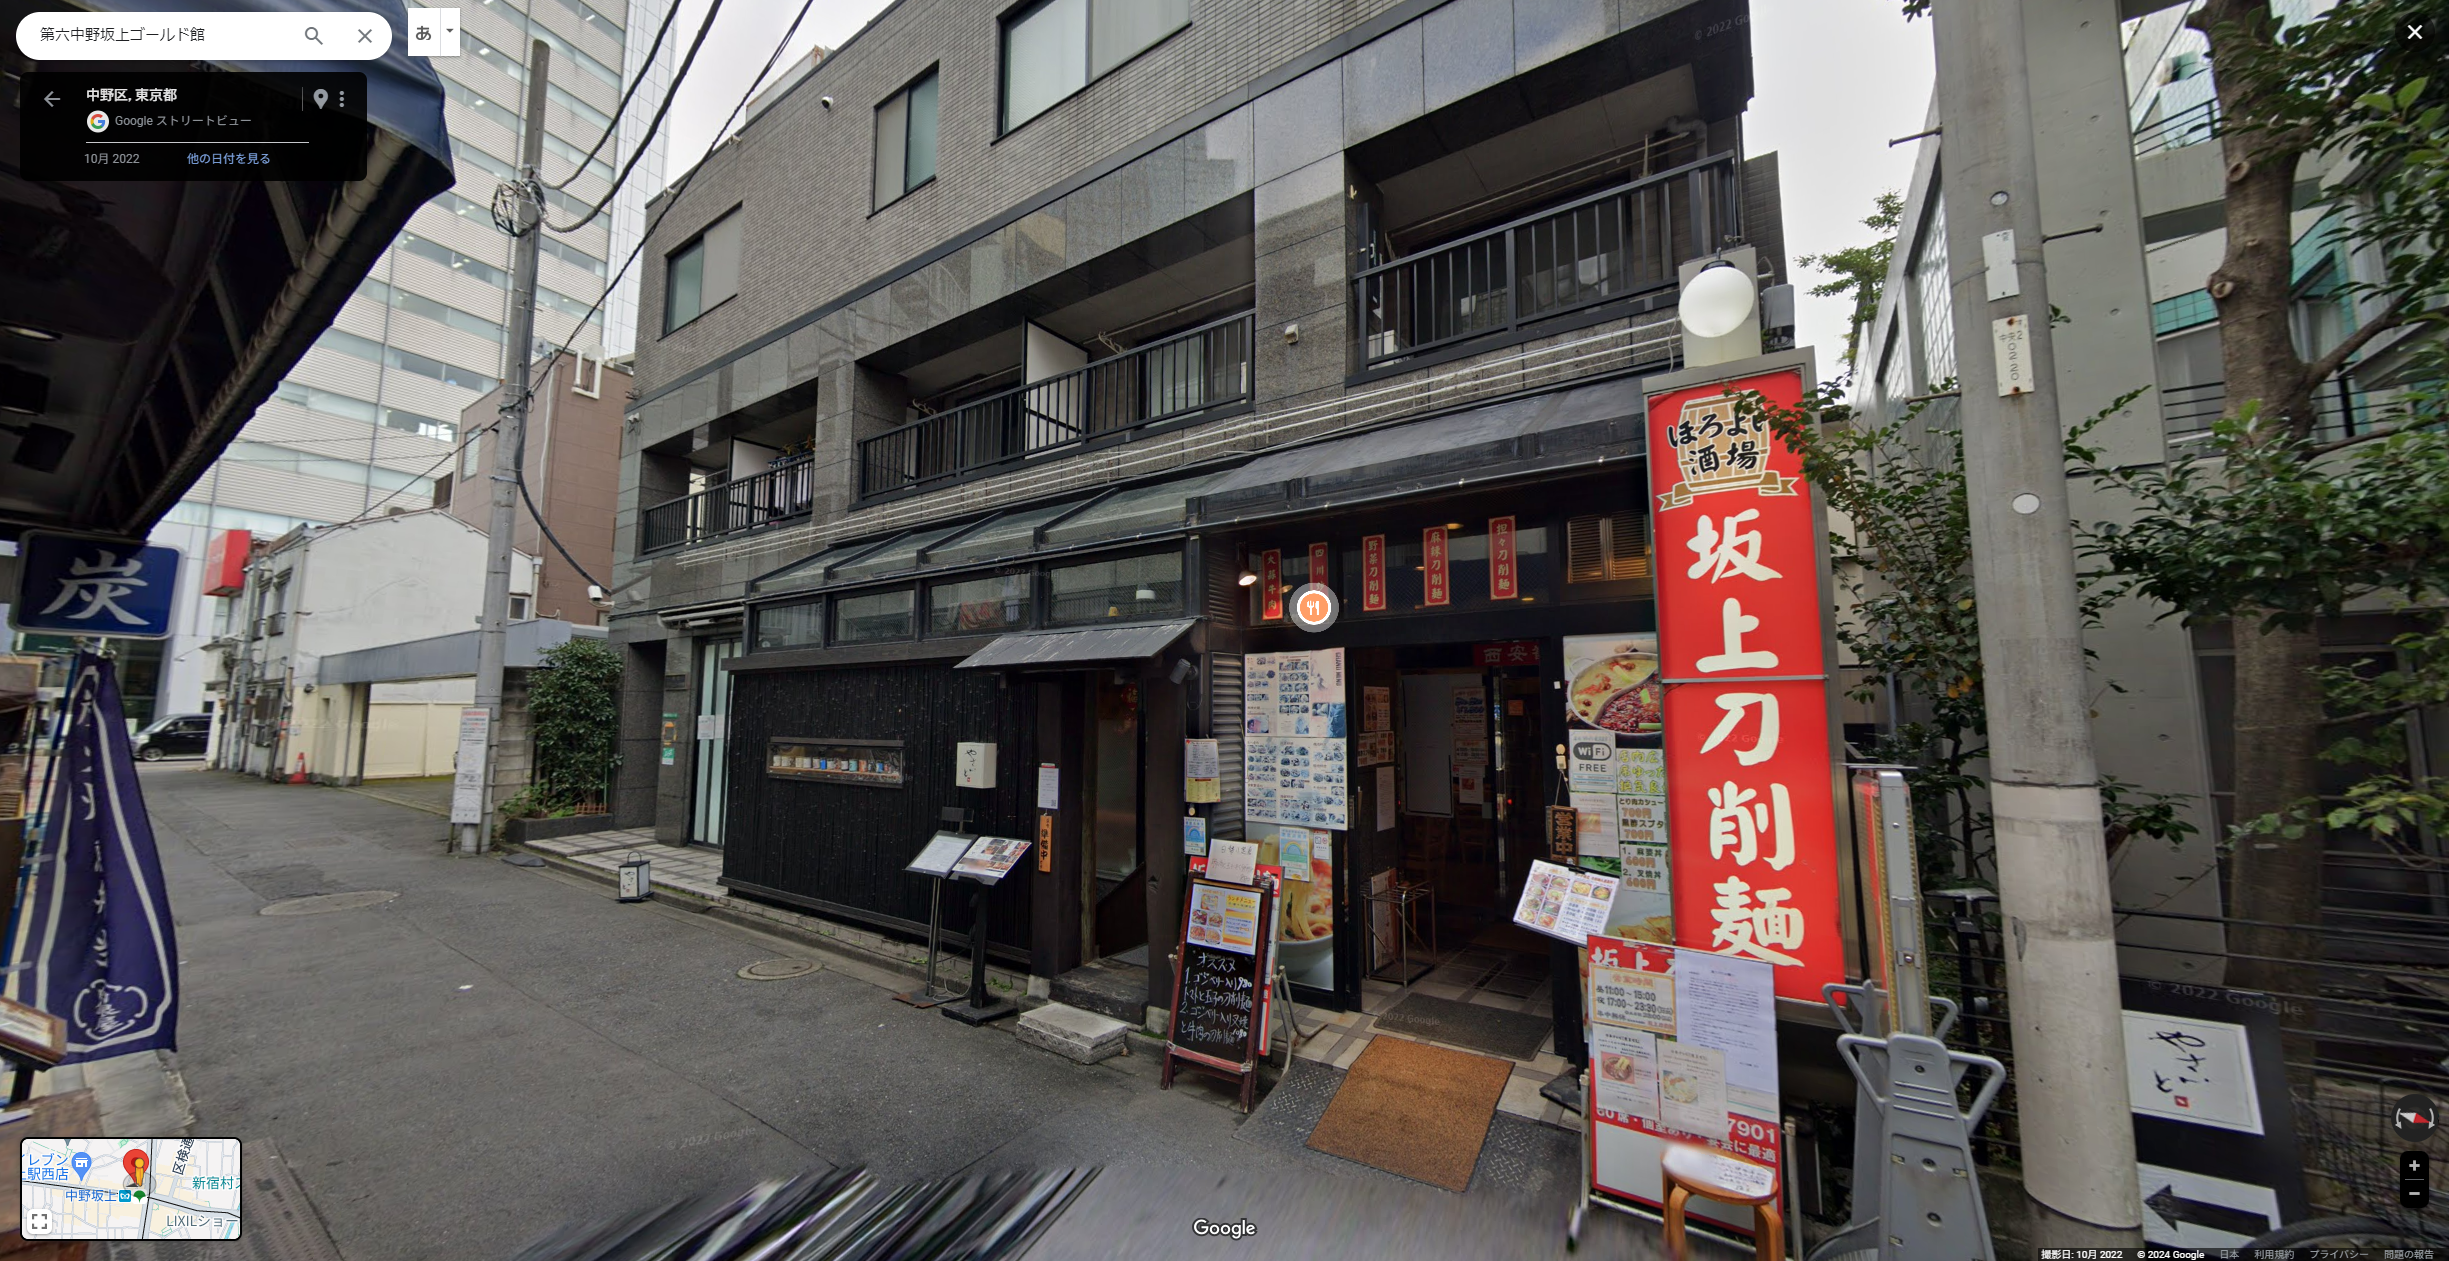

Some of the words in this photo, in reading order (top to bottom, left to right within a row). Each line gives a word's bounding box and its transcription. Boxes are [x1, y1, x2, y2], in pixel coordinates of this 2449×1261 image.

[1689, 440, 1760, 475] 酒場
[39, 549, 150, 625] 炭
[1686, 509, 1805, 967] 坂上刀削麺
[1579, 764, 1607, 772] FREE
[1555, 812, 1574, 856] 営業中
[1633, 990, 1656, 1001] 15:00
